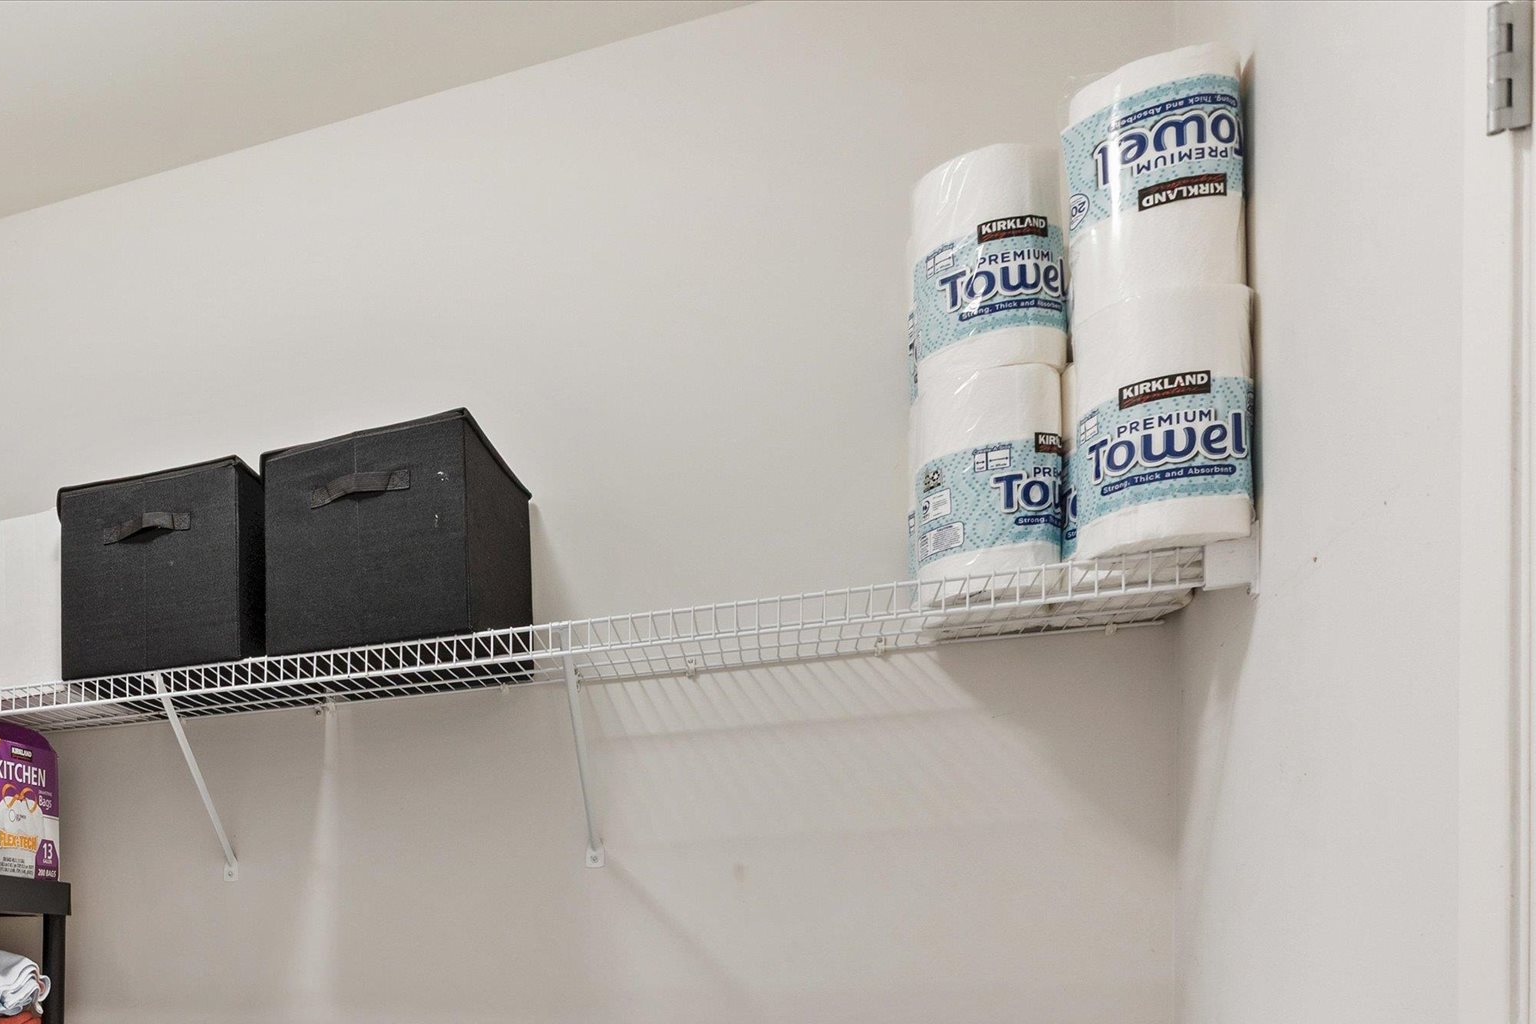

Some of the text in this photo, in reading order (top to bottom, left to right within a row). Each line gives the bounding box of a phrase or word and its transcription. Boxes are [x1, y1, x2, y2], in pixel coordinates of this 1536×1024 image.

[1166, 101, 1184, 110] and
[1136, 146, 1228, 175] PREMIUM
[1141, 182, 1225, 207] KIRKLAND
[981, 217, 1046, 235] KIRKLAND
[978, 249, 1049, 267] PREMIUM
[938, 258, 1069, 312] Towel
[1020, 299, 1035, 307] and
[1122, 373, 1208, 400] KIRKLAND
[1117, 409, 1212, 438] PREMIUM
[1089, 412, 1246, 481] Towel
[1134, 473, 1160, 484] Thick
[1165, 468, 1184, 477] and
[1187, 465, 1232, 475] Absorbent
[38, 794, 53, 811] Bags
[42, 842, 53, 860] 13
